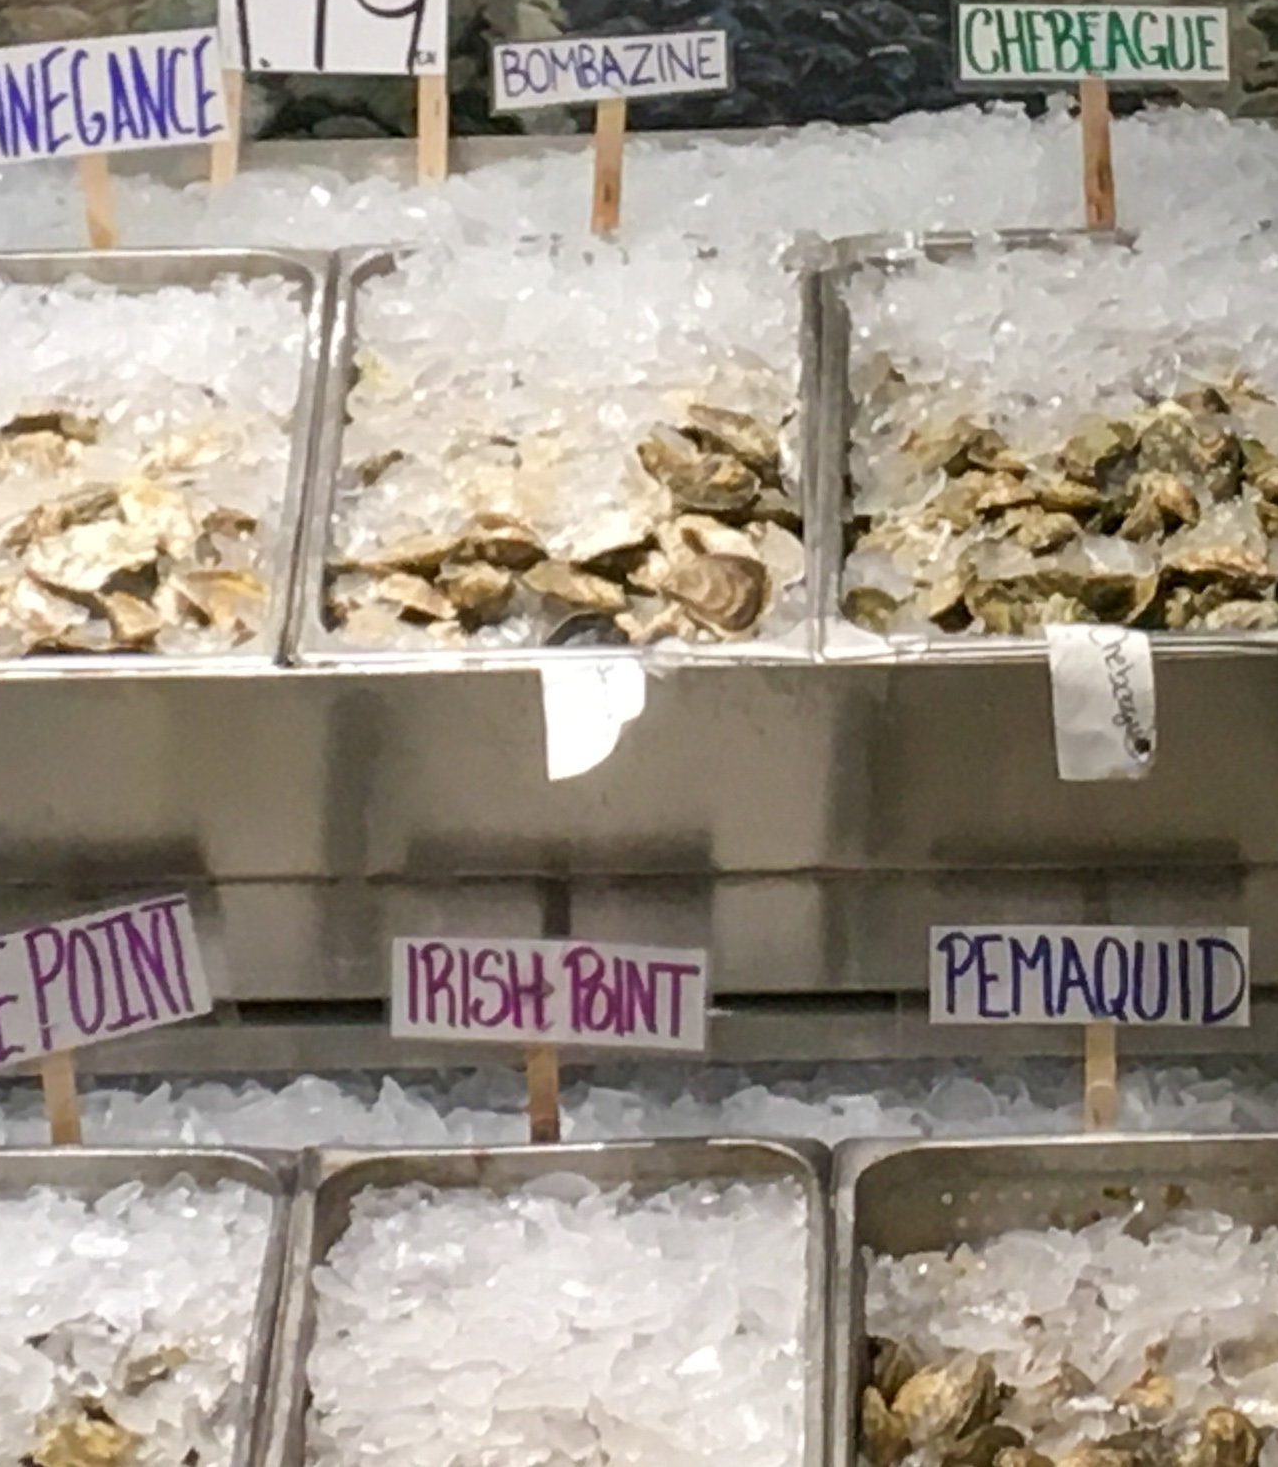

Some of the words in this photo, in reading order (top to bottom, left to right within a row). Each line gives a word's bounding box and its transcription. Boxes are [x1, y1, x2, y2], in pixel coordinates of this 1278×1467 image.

[500, 37, 721, 98] BOMBAZINE
[961, 5, 1225, 76] CHEBEAGUE
[21, 897, 197, 1053] POINT
[407, 941, 555, 1031] IRISH
[562, 946, 701, 1039] POINT
[937, 932, 1247, 1026] PEMAQUID
